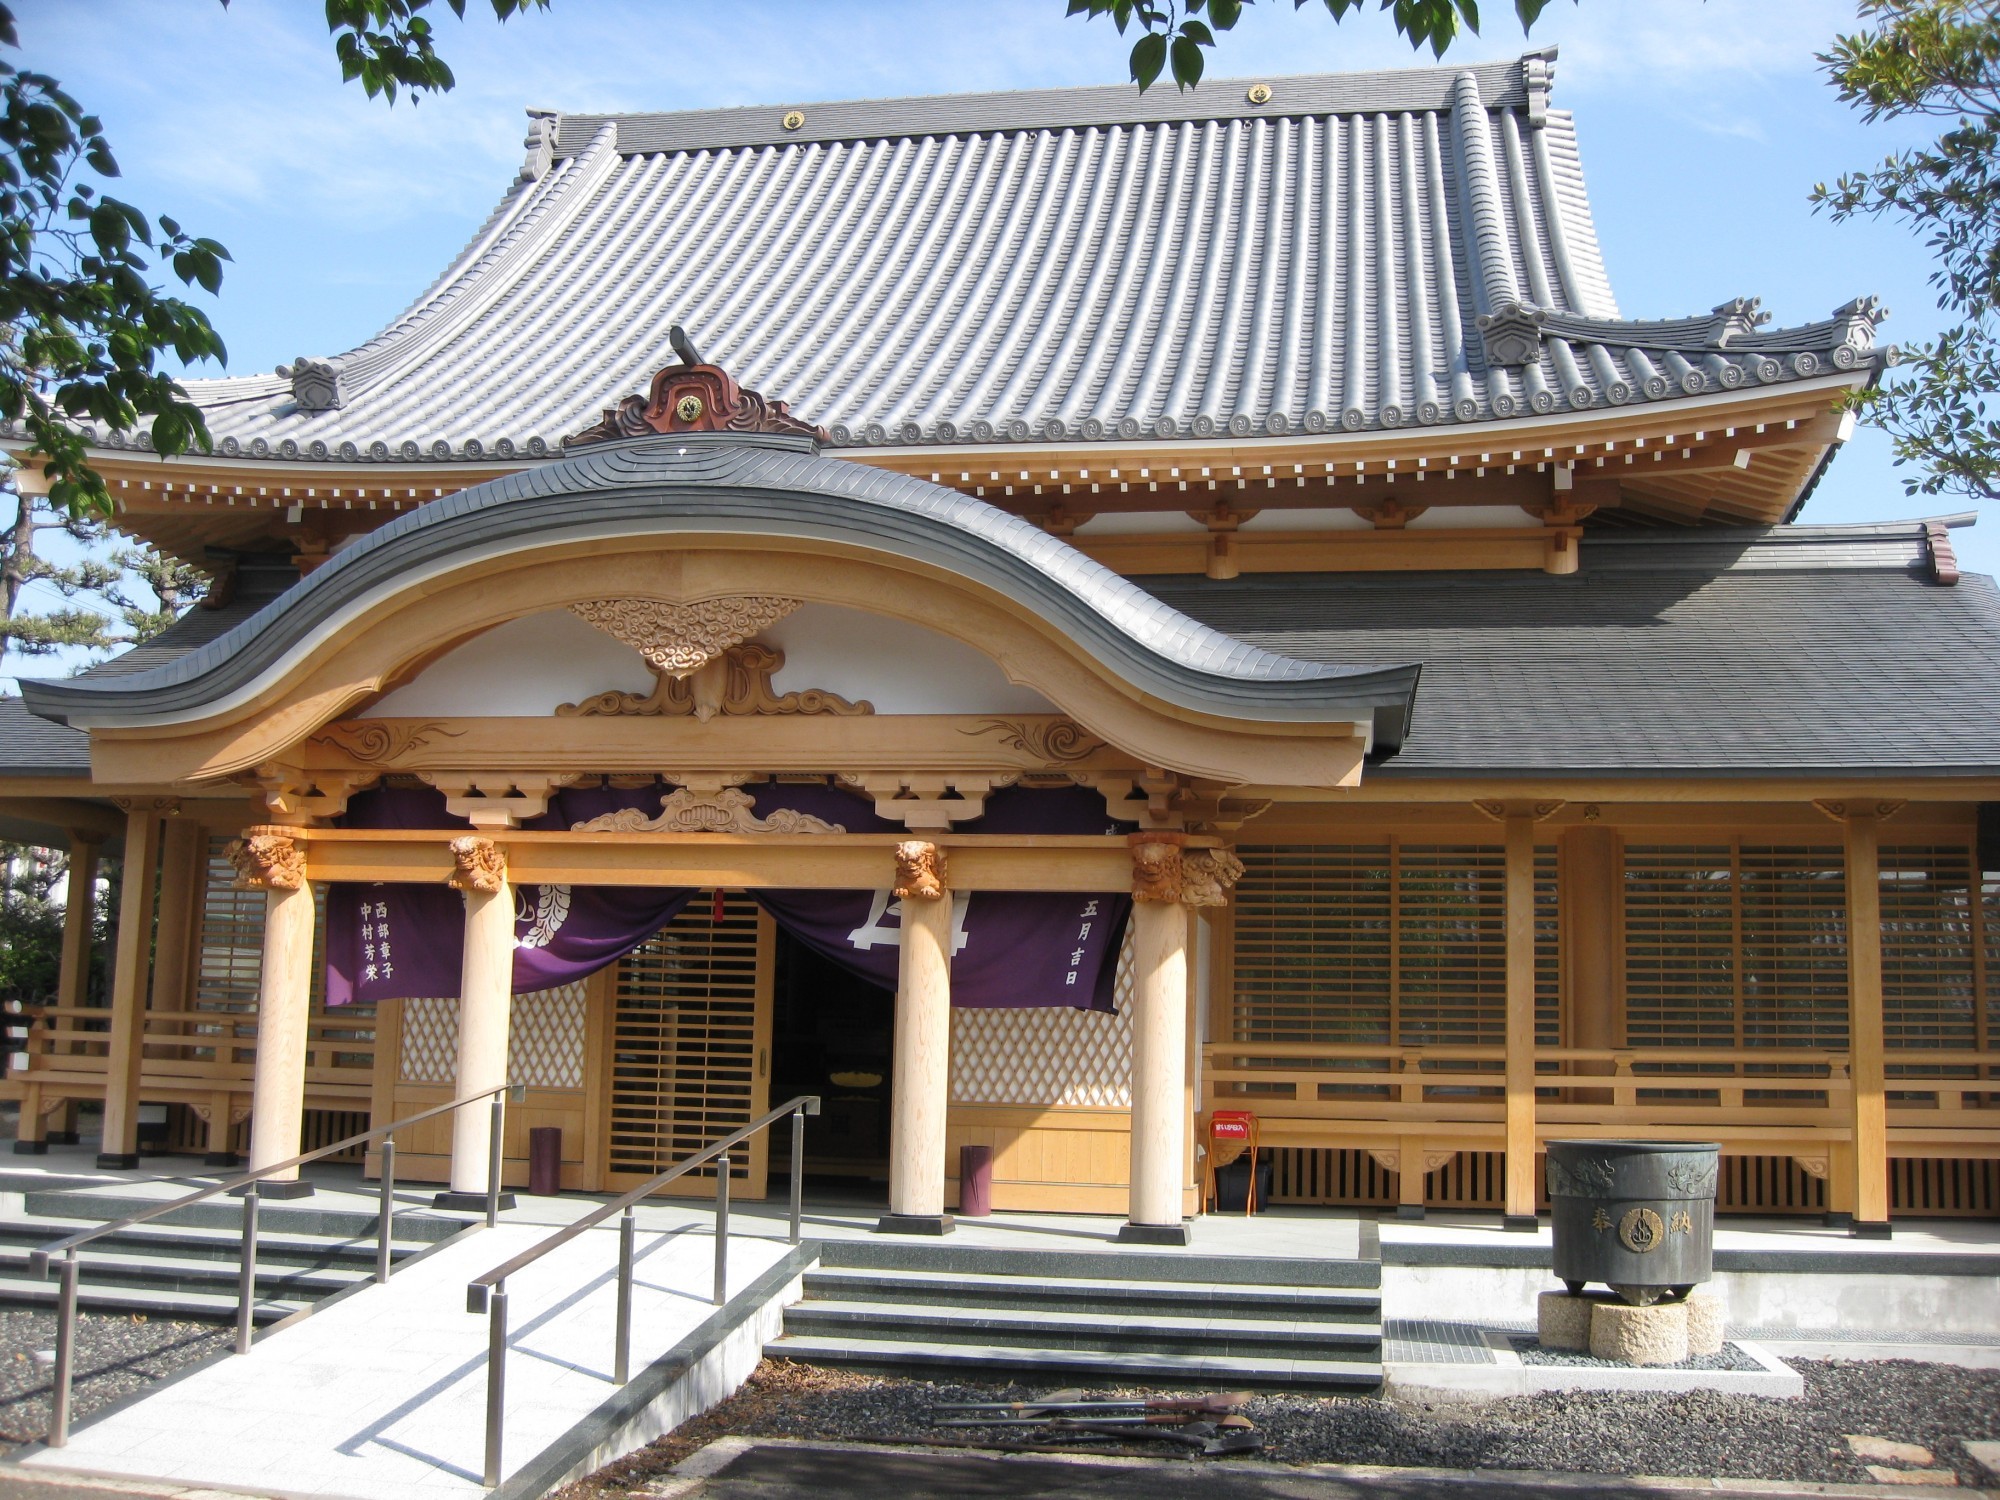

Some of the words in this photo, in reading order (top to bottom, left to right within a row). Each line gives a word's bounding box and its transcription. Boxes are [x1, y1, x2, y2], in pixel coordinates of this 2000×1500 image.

[360, 902, 379, 982] 中村芳栄
[375, 901, 394, 979] 西部章子
[1065, 900, 1099, 985] 五月吉日
